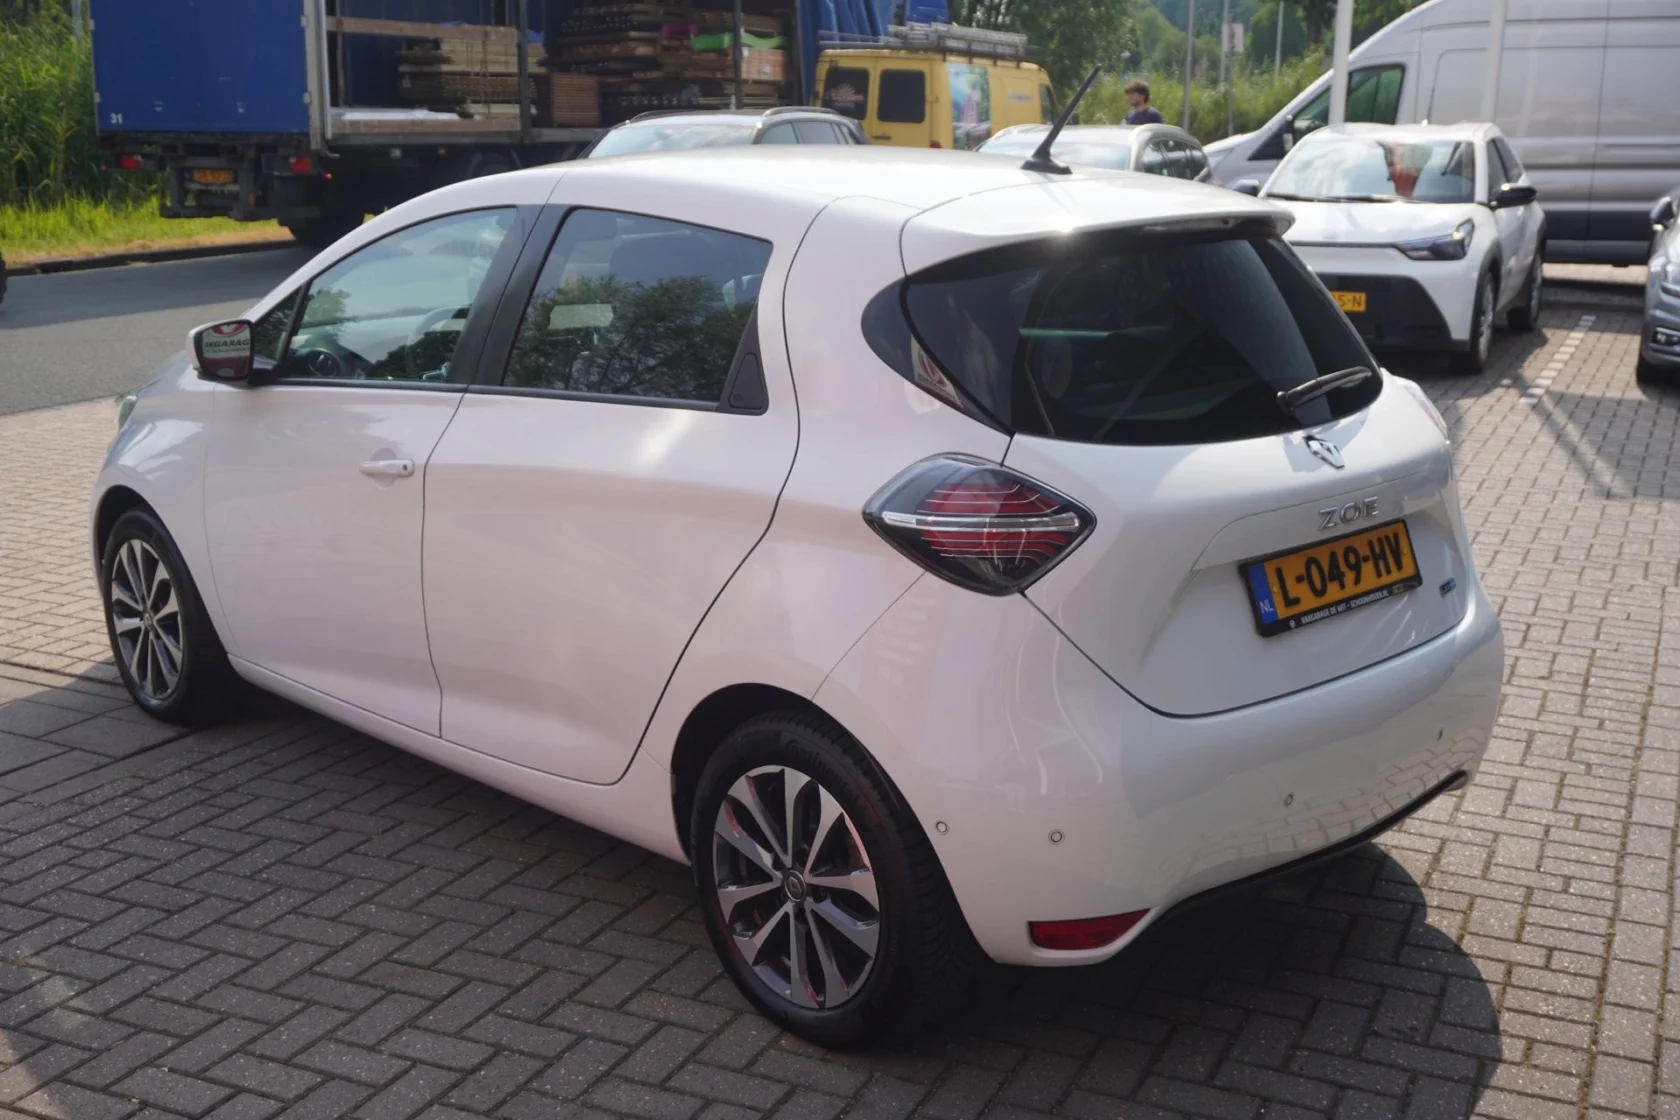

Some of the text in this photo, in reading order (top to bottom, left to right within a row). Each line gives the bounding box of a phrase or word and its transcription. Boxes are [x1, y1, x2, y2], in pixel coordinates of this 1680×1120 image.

[109, 112, 123, 125] 31
[1318, 496, 1379, 531] ZOE
[1275, 532, 1404, 608] L-049-HV
[1259, 599, 1274, 614] NL
[1329, 606, 1338, 615] DE
[1337, 603, 1347, 612] WIT
